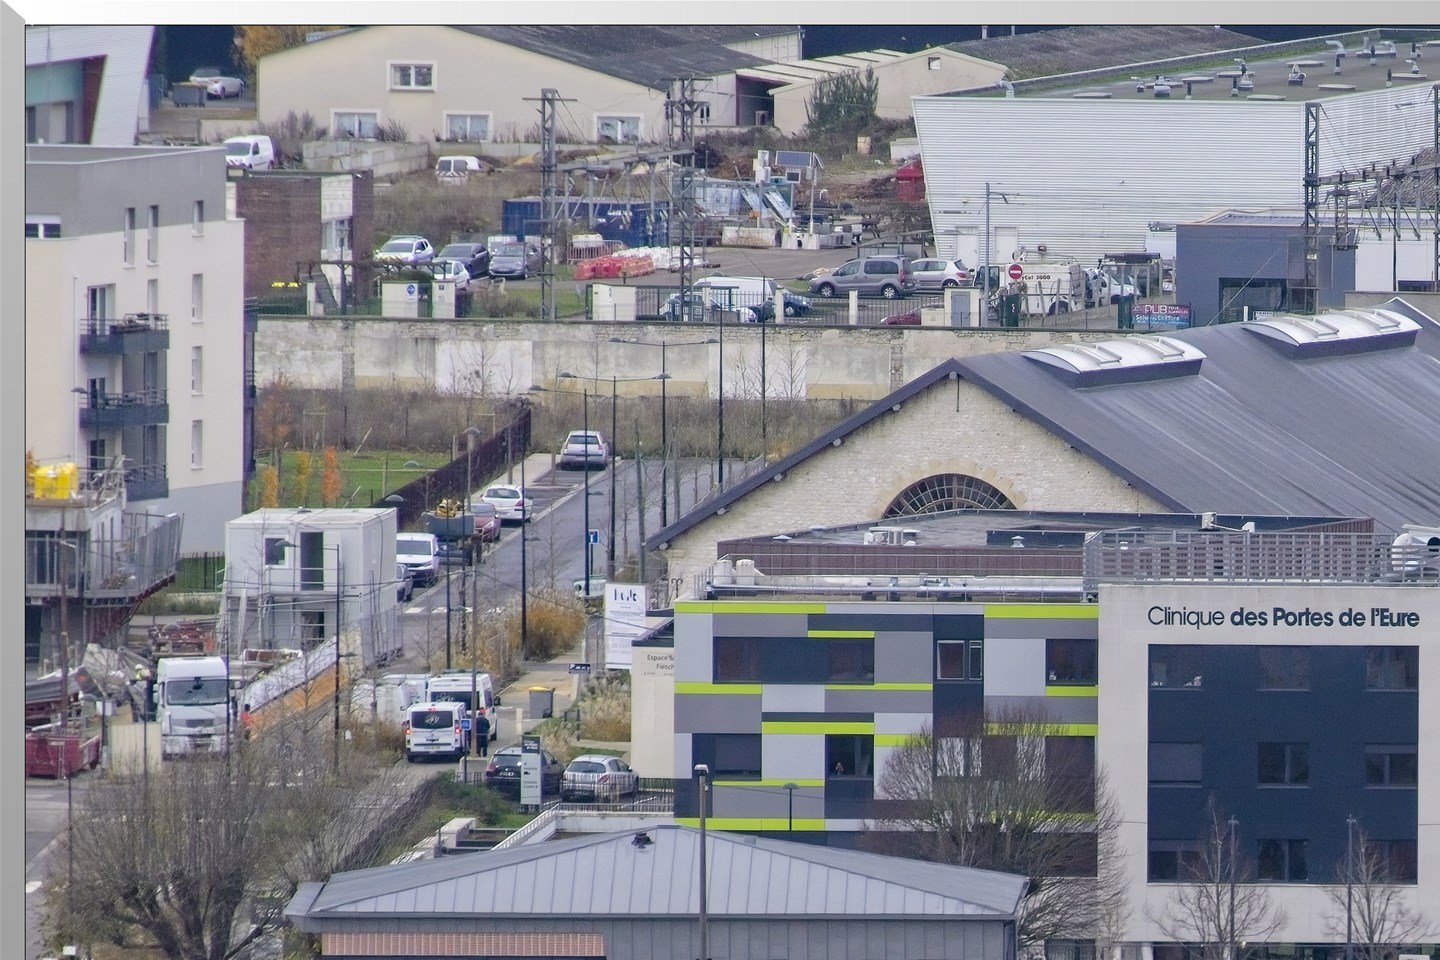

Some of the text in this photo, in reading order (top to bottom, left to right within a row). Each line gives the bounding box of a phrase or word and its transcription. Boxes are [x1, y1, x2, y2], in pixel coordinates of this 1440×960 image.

[1147, 606, 1420, 630] Clinique des Portes de l'Eure
